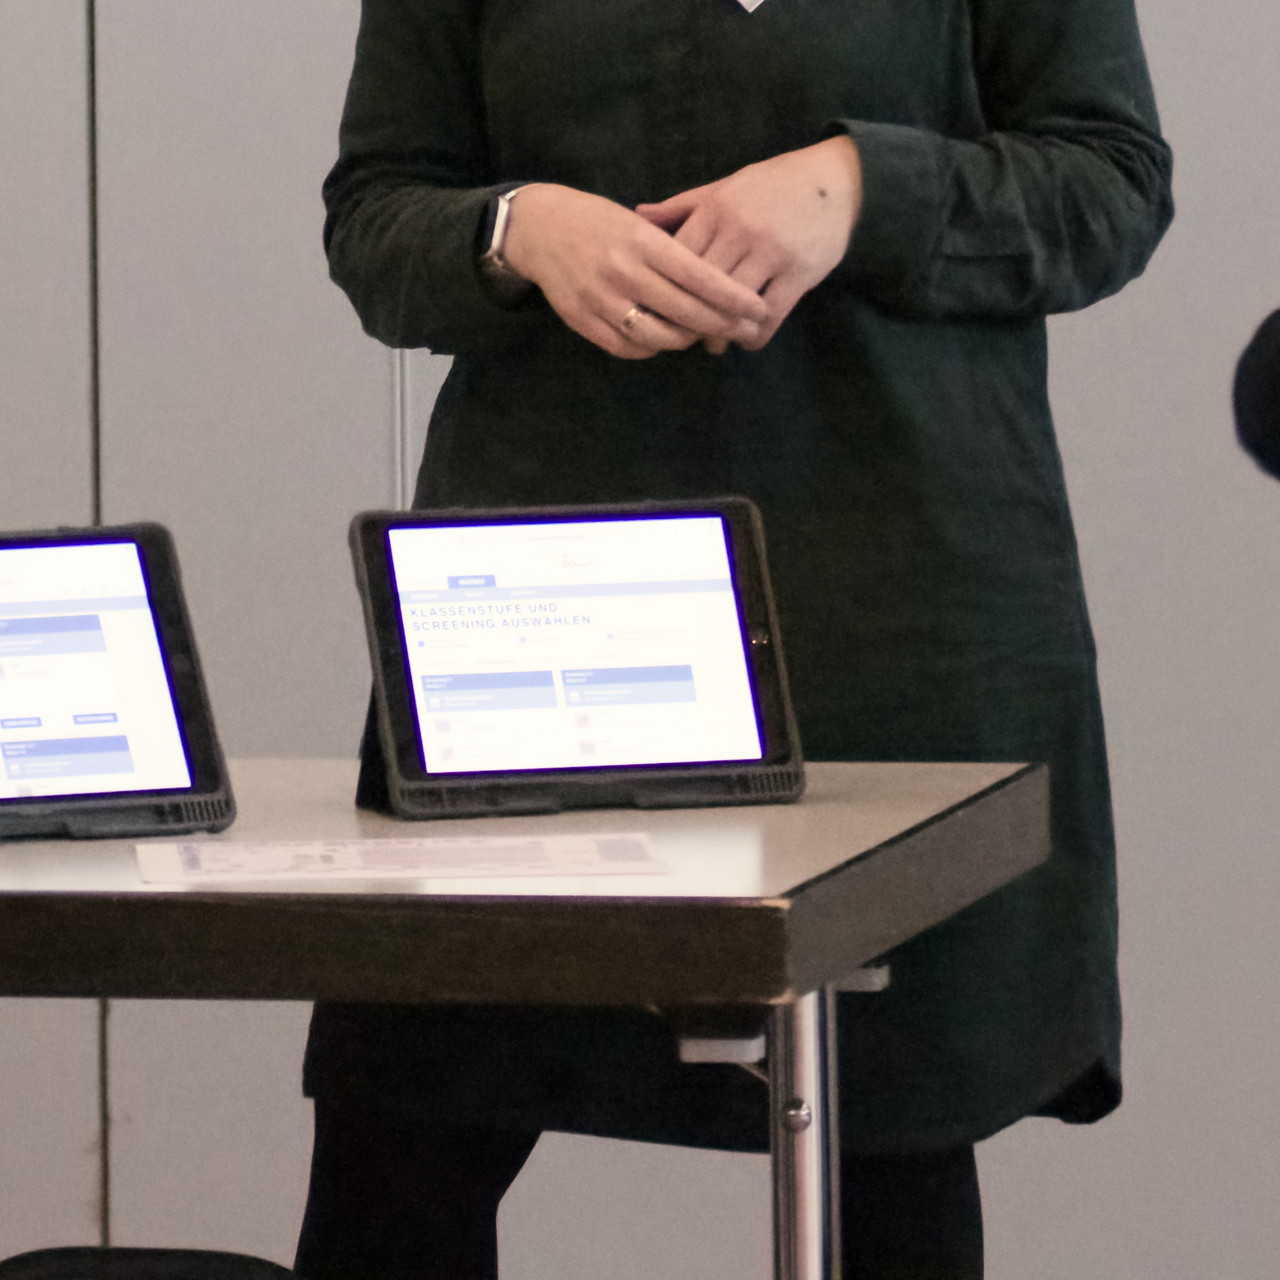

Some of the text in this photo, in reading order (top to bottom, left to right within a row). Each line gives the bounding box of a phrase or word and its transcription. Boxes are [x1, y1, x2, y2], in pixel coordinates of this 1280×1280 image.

[410, 602, 558, 617] KLASSENSTUFE UND
[412, 618, 496, 632] SCREENING
